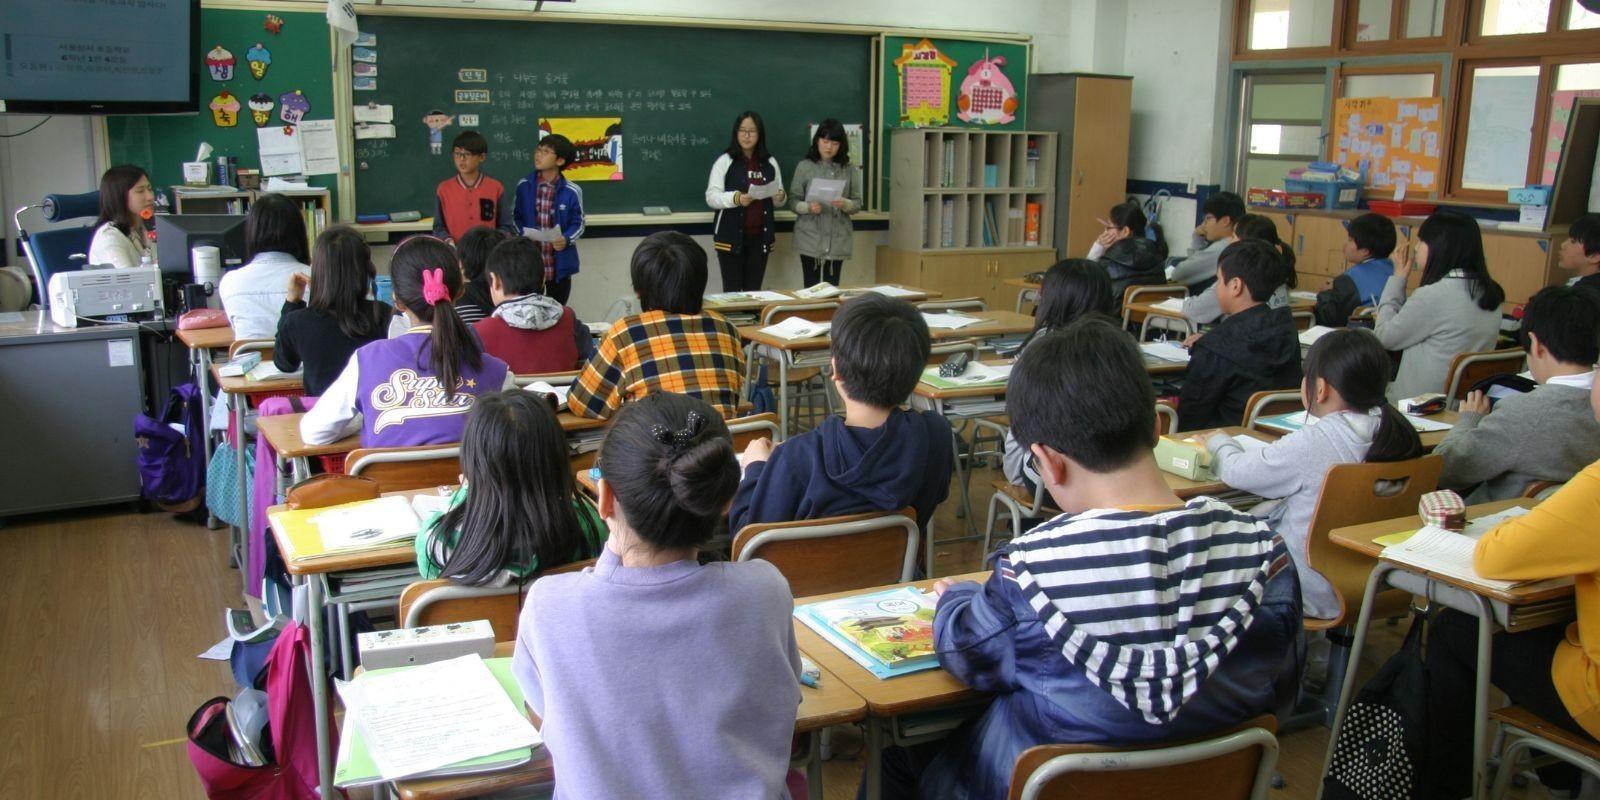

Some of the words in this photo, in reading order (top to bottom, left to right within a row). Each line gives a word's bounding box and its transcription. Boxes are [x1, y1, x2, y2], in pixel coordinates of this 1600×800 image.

[215, 65, 229, 80] 생
[250, 61, 267, 77] 일
[218, 107, 232, 125] 축
[253, 110, 269, 124] 하
[283, 108, 300, 124] 해
[479, 198, 495, 222] B
[371, 368, 464, 411] Sup
